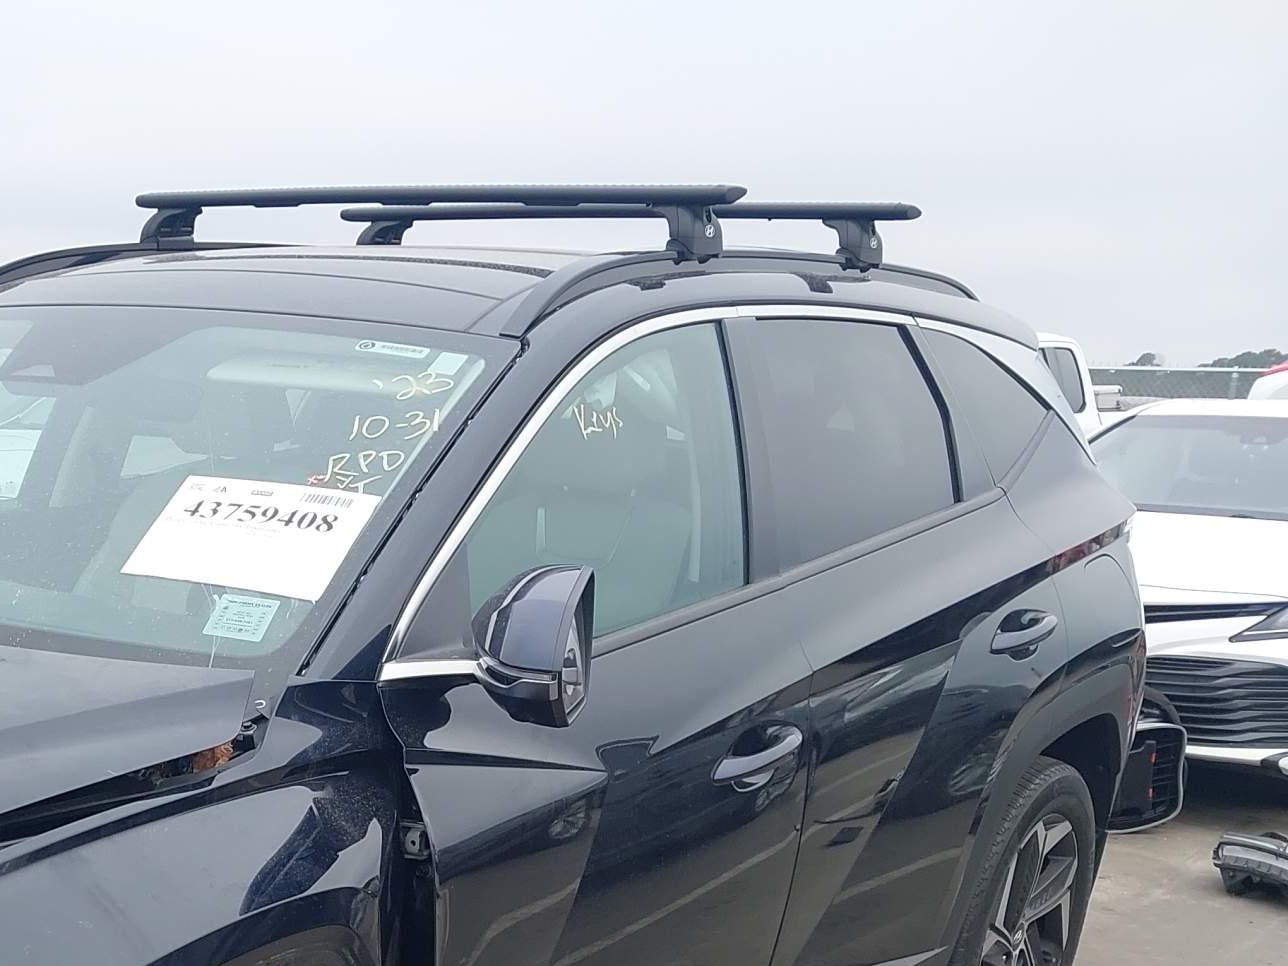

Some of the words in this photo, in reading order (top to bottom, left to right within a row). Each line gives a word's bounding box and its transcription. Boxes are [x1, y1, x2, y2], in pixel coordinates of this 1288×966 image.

[348, 408, 441, 441] 10-31
[323, 449, 405, 482] RPD
[183, 499, 339, 533] 43759408
